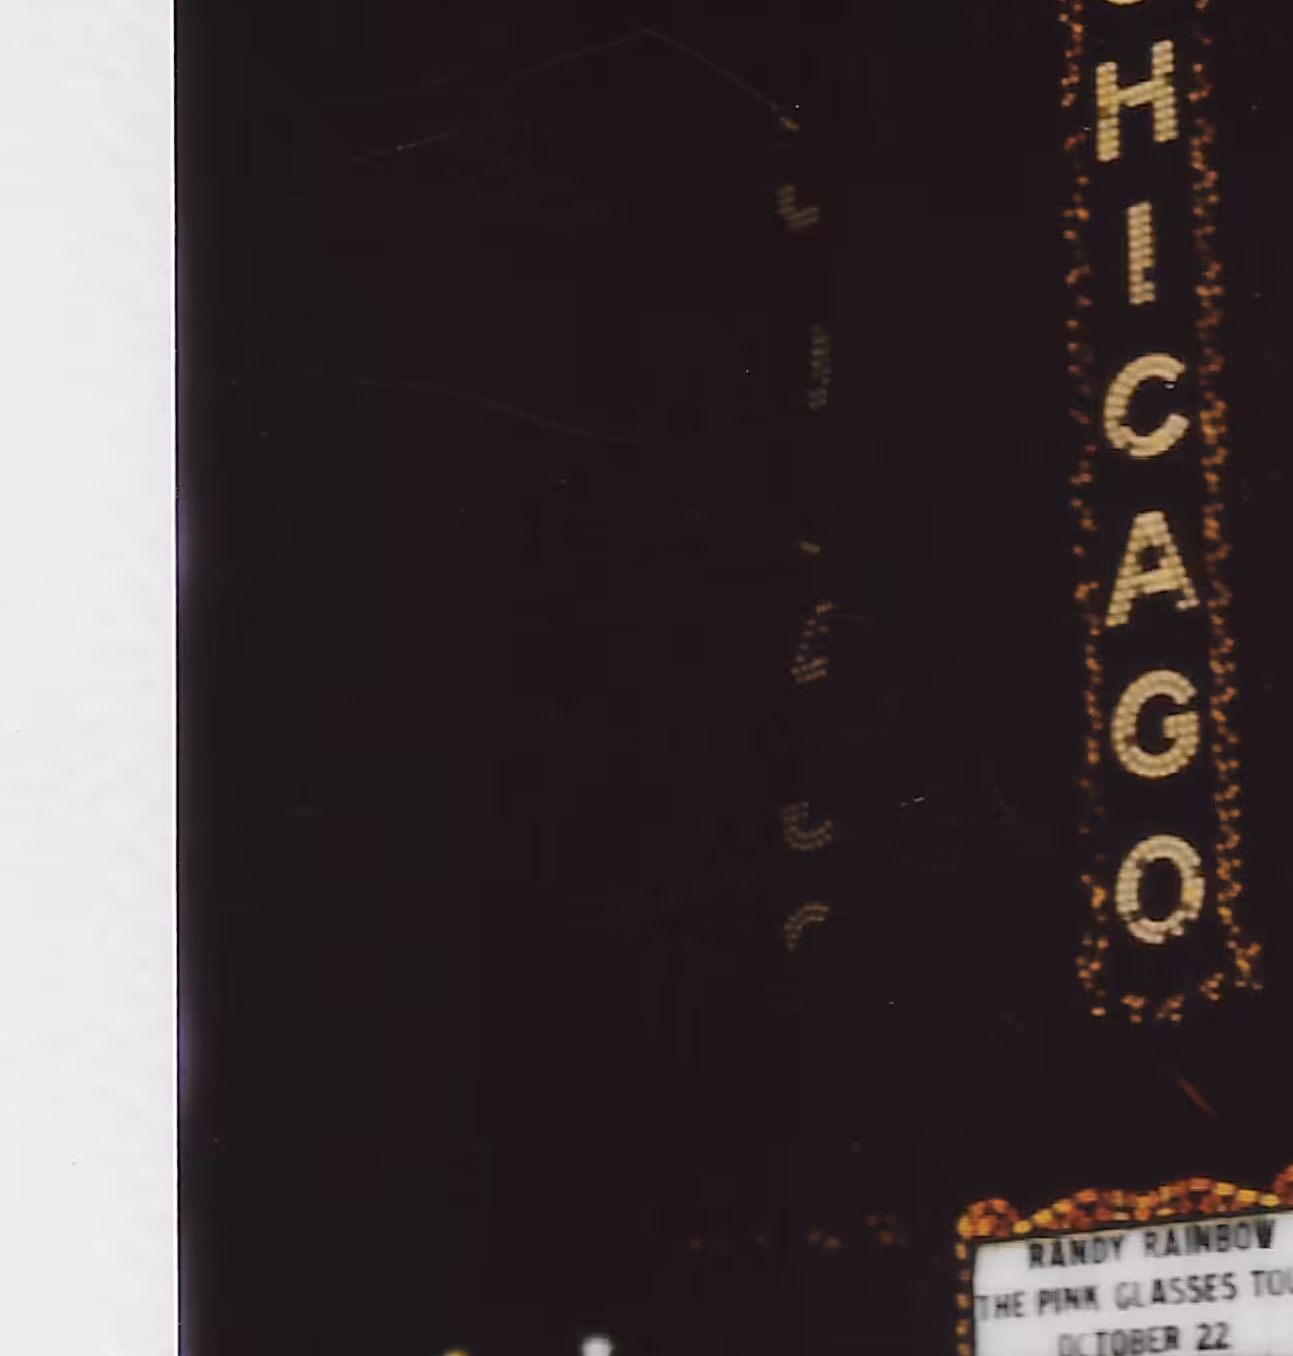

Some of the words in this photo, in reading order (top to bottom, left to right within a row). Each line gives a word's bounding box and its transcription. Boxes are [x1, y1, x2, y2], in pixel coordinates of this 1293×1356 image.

[1028, 1236, 1126, 1269] RANDY
[1143, 1218, 1276, 1258] RAINBOW
[978, 1289, 1026, 1320] THE
[1038, 1283, 1100, 1316] PINK
[1113, 1271, 1239, 1311] GLASSES
[1197, 1320, 1231, 1350] 22
